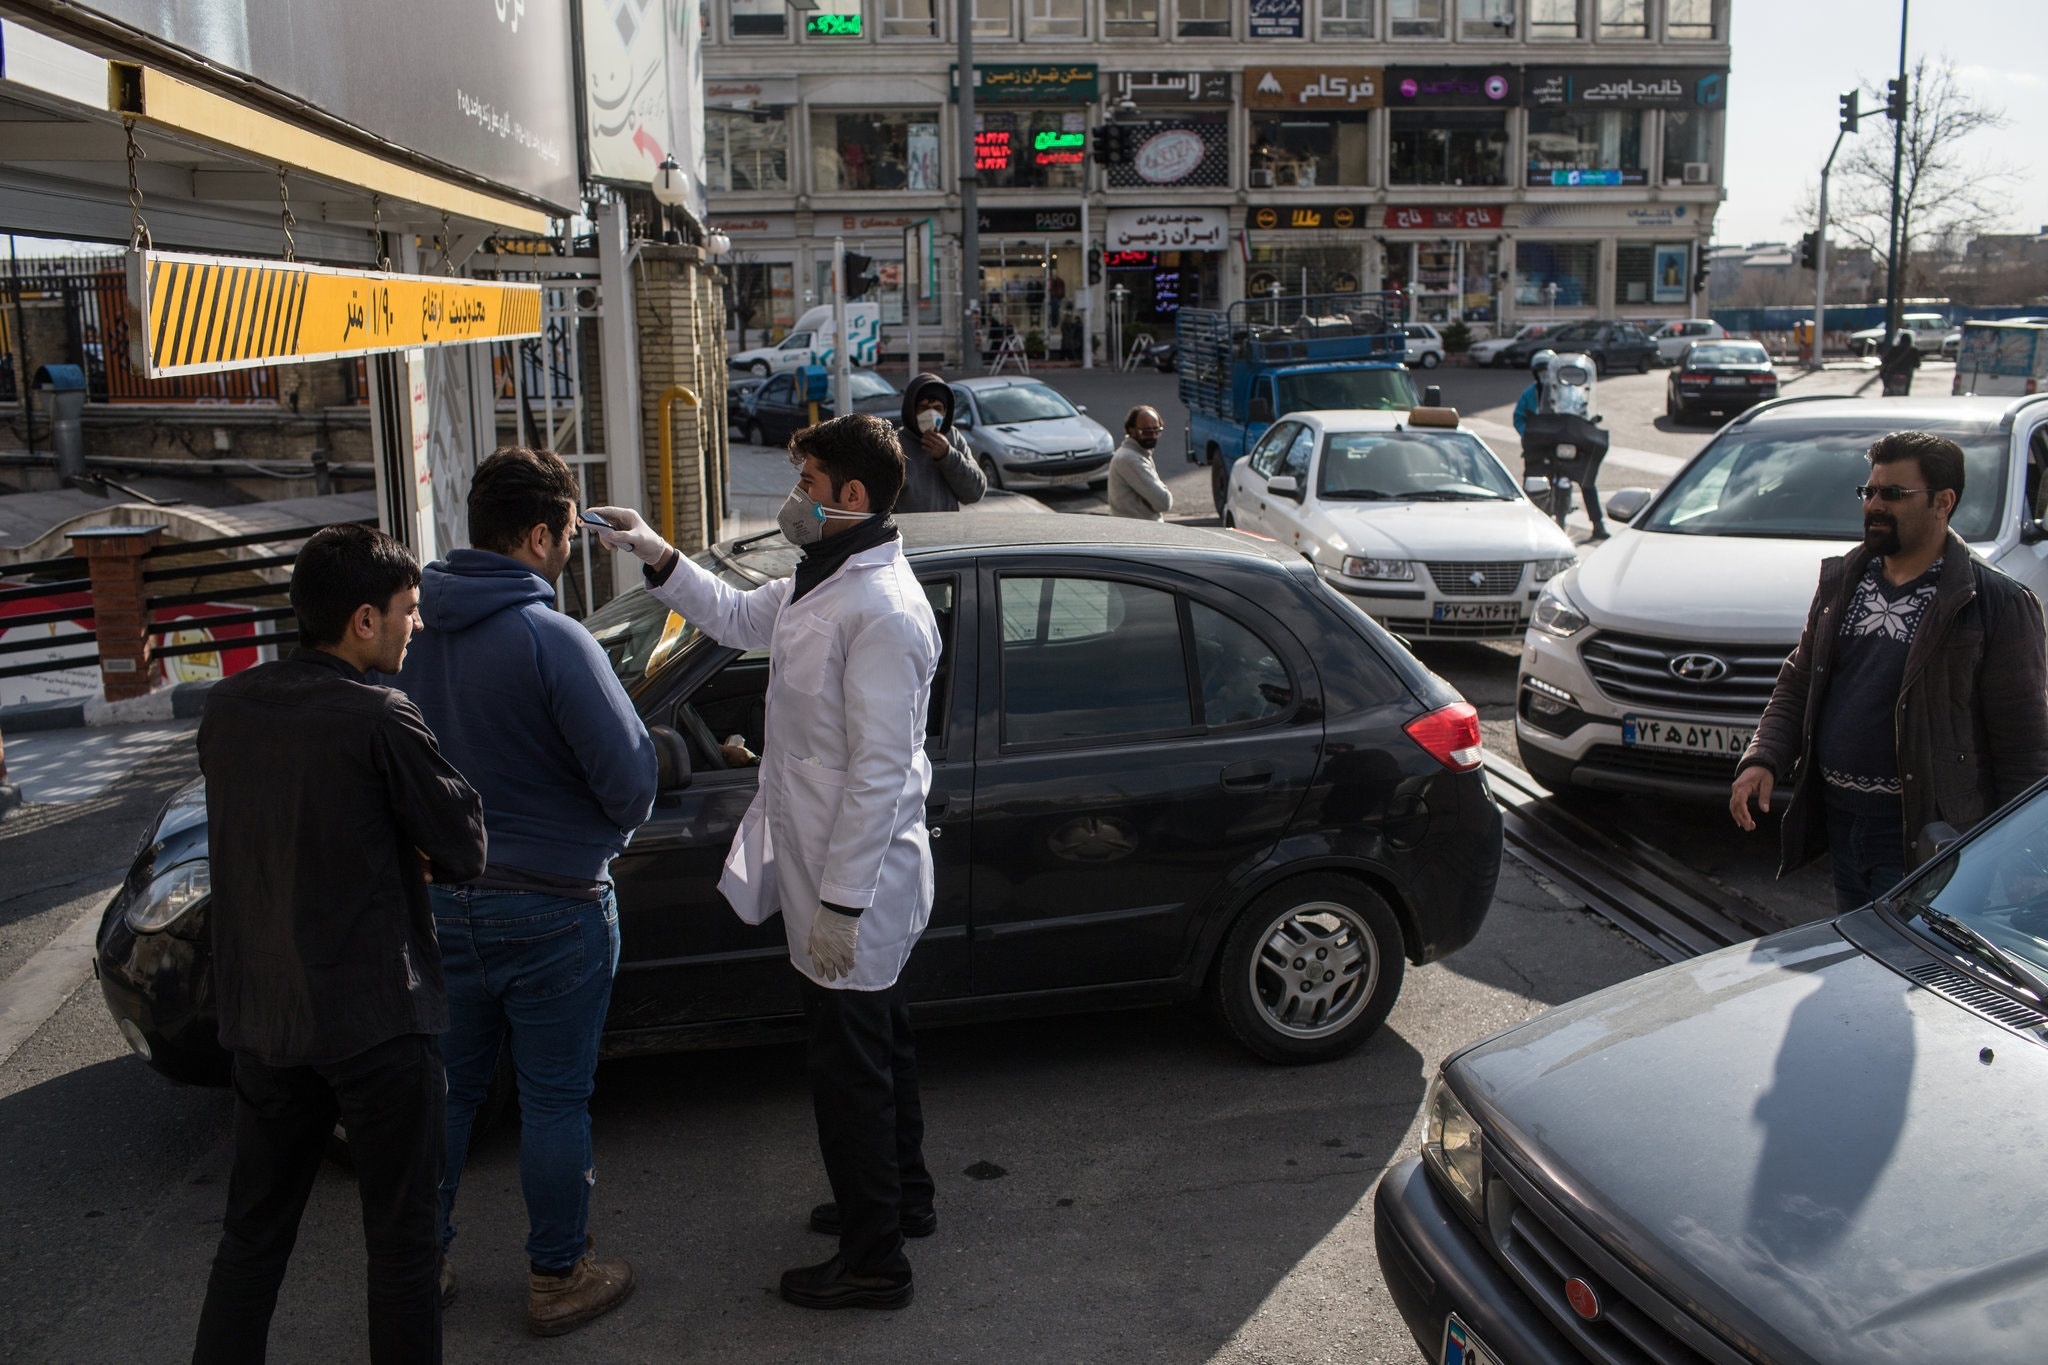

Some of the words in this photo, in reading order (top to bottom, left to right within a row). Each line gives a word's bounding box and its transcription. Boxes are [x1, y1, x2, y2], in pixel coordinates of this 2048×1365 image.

[986, 70, 1021, 84] زمین
[1022, 67, 1060, 85] تهران
[1060, 67, 1093, 84] مسکن
[1299, 74, 1375, 104] فرکام
[1035, 212, 1077, 227] PARCO
[1118, 228, 1168, 246] زمین
[1171, 226, 1220, 246] ایران
[343, 290, 364, 343] متر
[421, 288, 445, 342] ارتفاع
[449, 295, 486, 335] محدودیت
